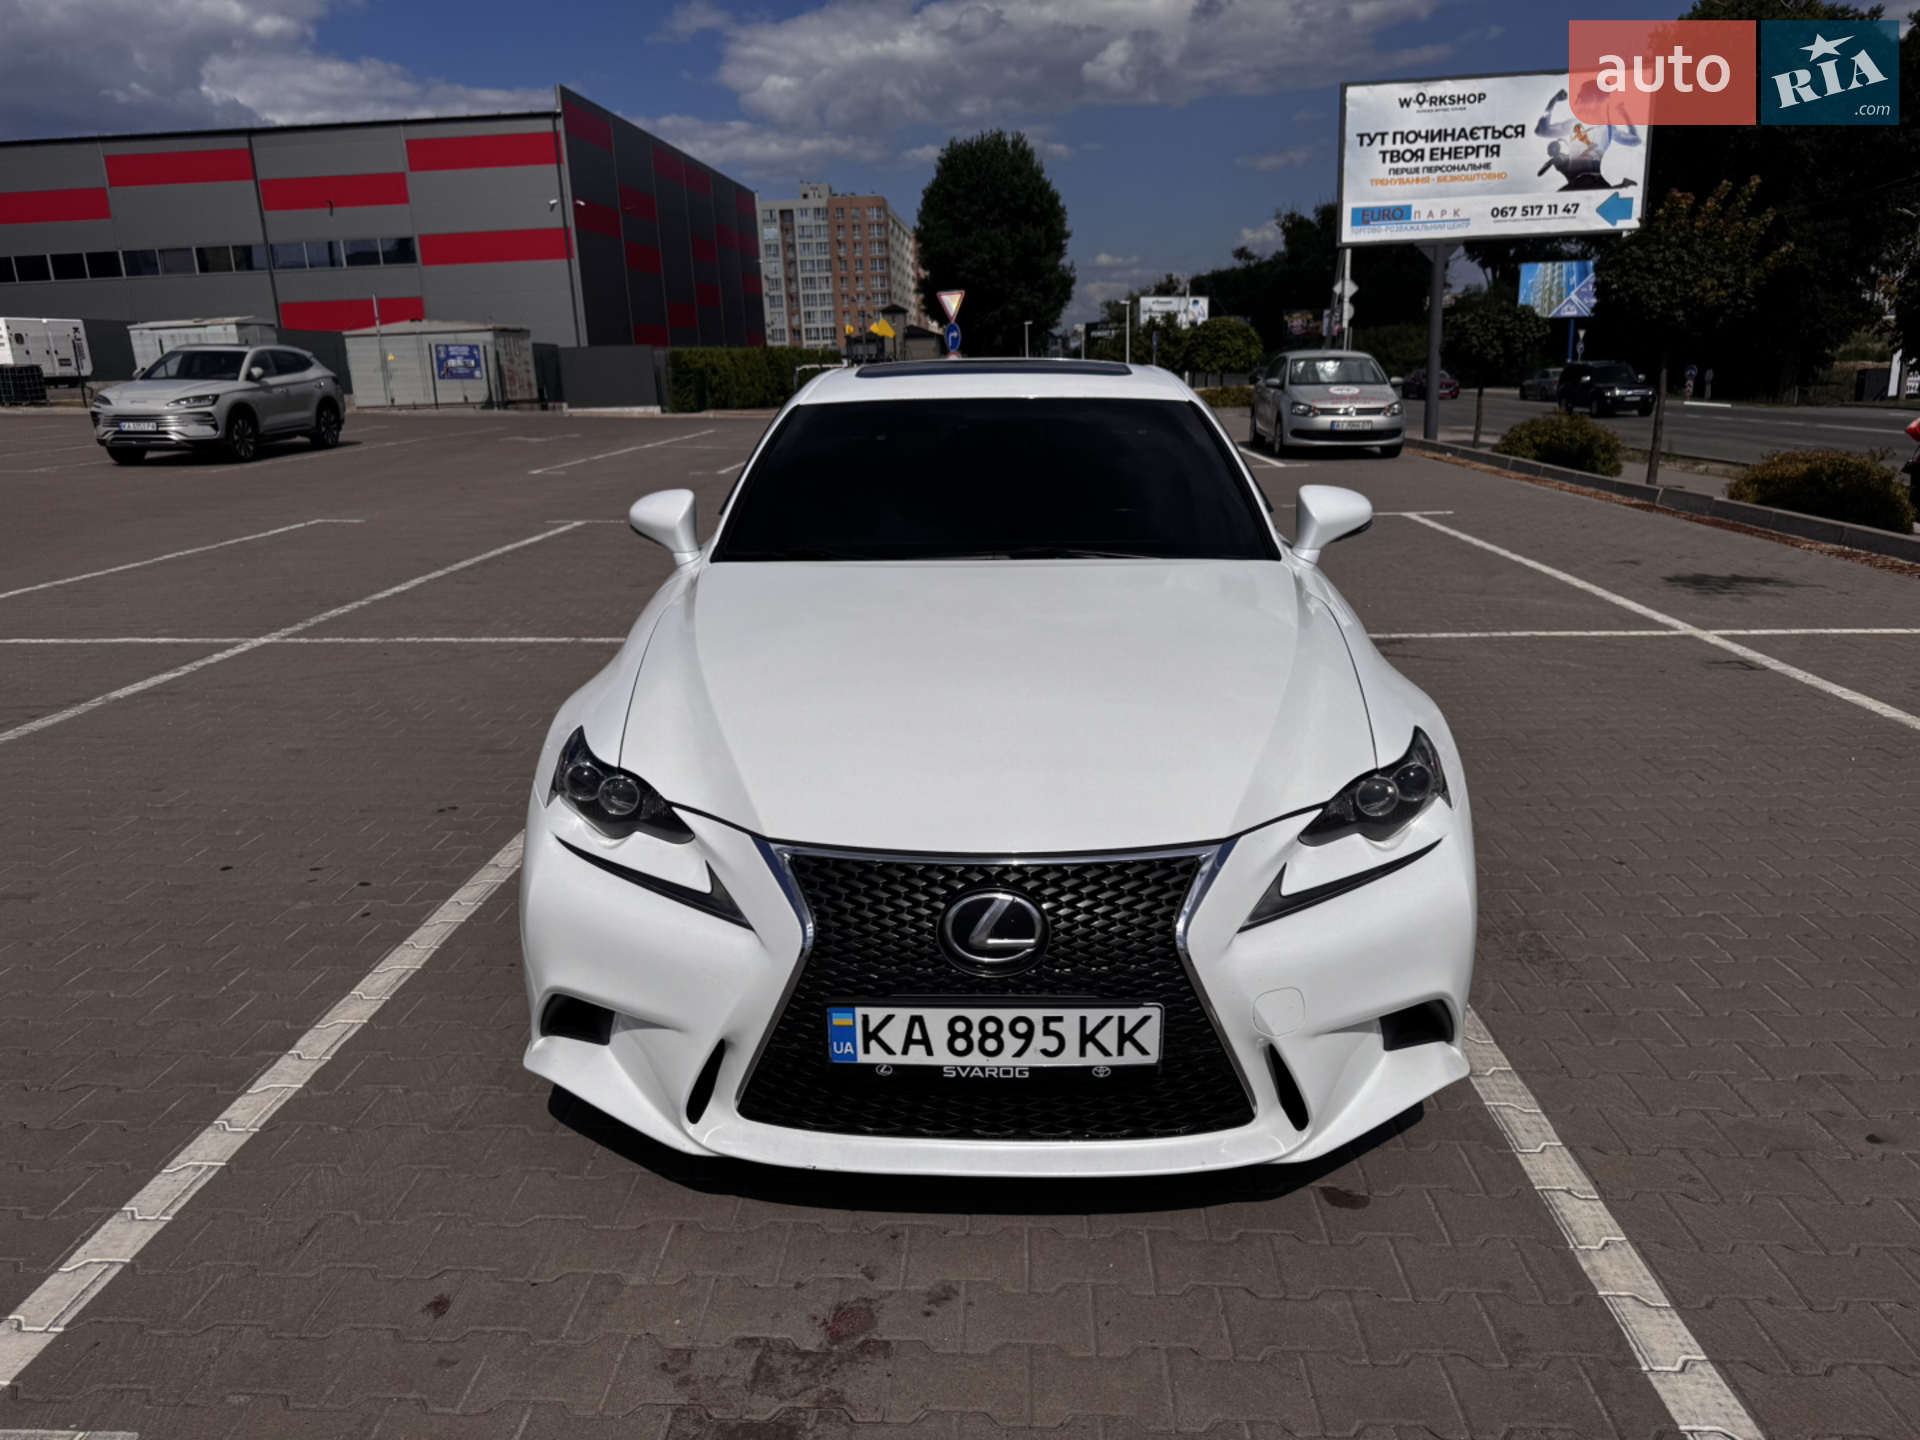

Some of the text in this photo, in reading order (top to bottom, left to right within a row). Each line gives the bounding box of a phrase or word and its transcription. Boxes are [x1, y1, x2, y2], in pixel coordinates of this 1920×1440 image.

[1398, 92, 1487, 109] WORKSHOP
[1356, 124, 1526, 147] ТУТ ПОЧИНАЄТЬСЯ
[1379, 144, 1501, 164] ТВОЯ ЕНЕРГІЯ
[1388, 162, 1492, 176] ПЕРШЕ ПЕРСОНАЛЬНЕ
[1370, 176, 1431, 187] ТРЕНУВАННЯ
[1361, 207, 1405, 225] EURO
[1413, 208, 1461, 220] ПАРК
[1491, 203, 1580, 218] 067 517 11 47
[861, 1014, 1153, 1058] KA 8895 KK
[833, 1041, 854, 1054] UA
[943, 1066, 1030, 1078] SVAROG
